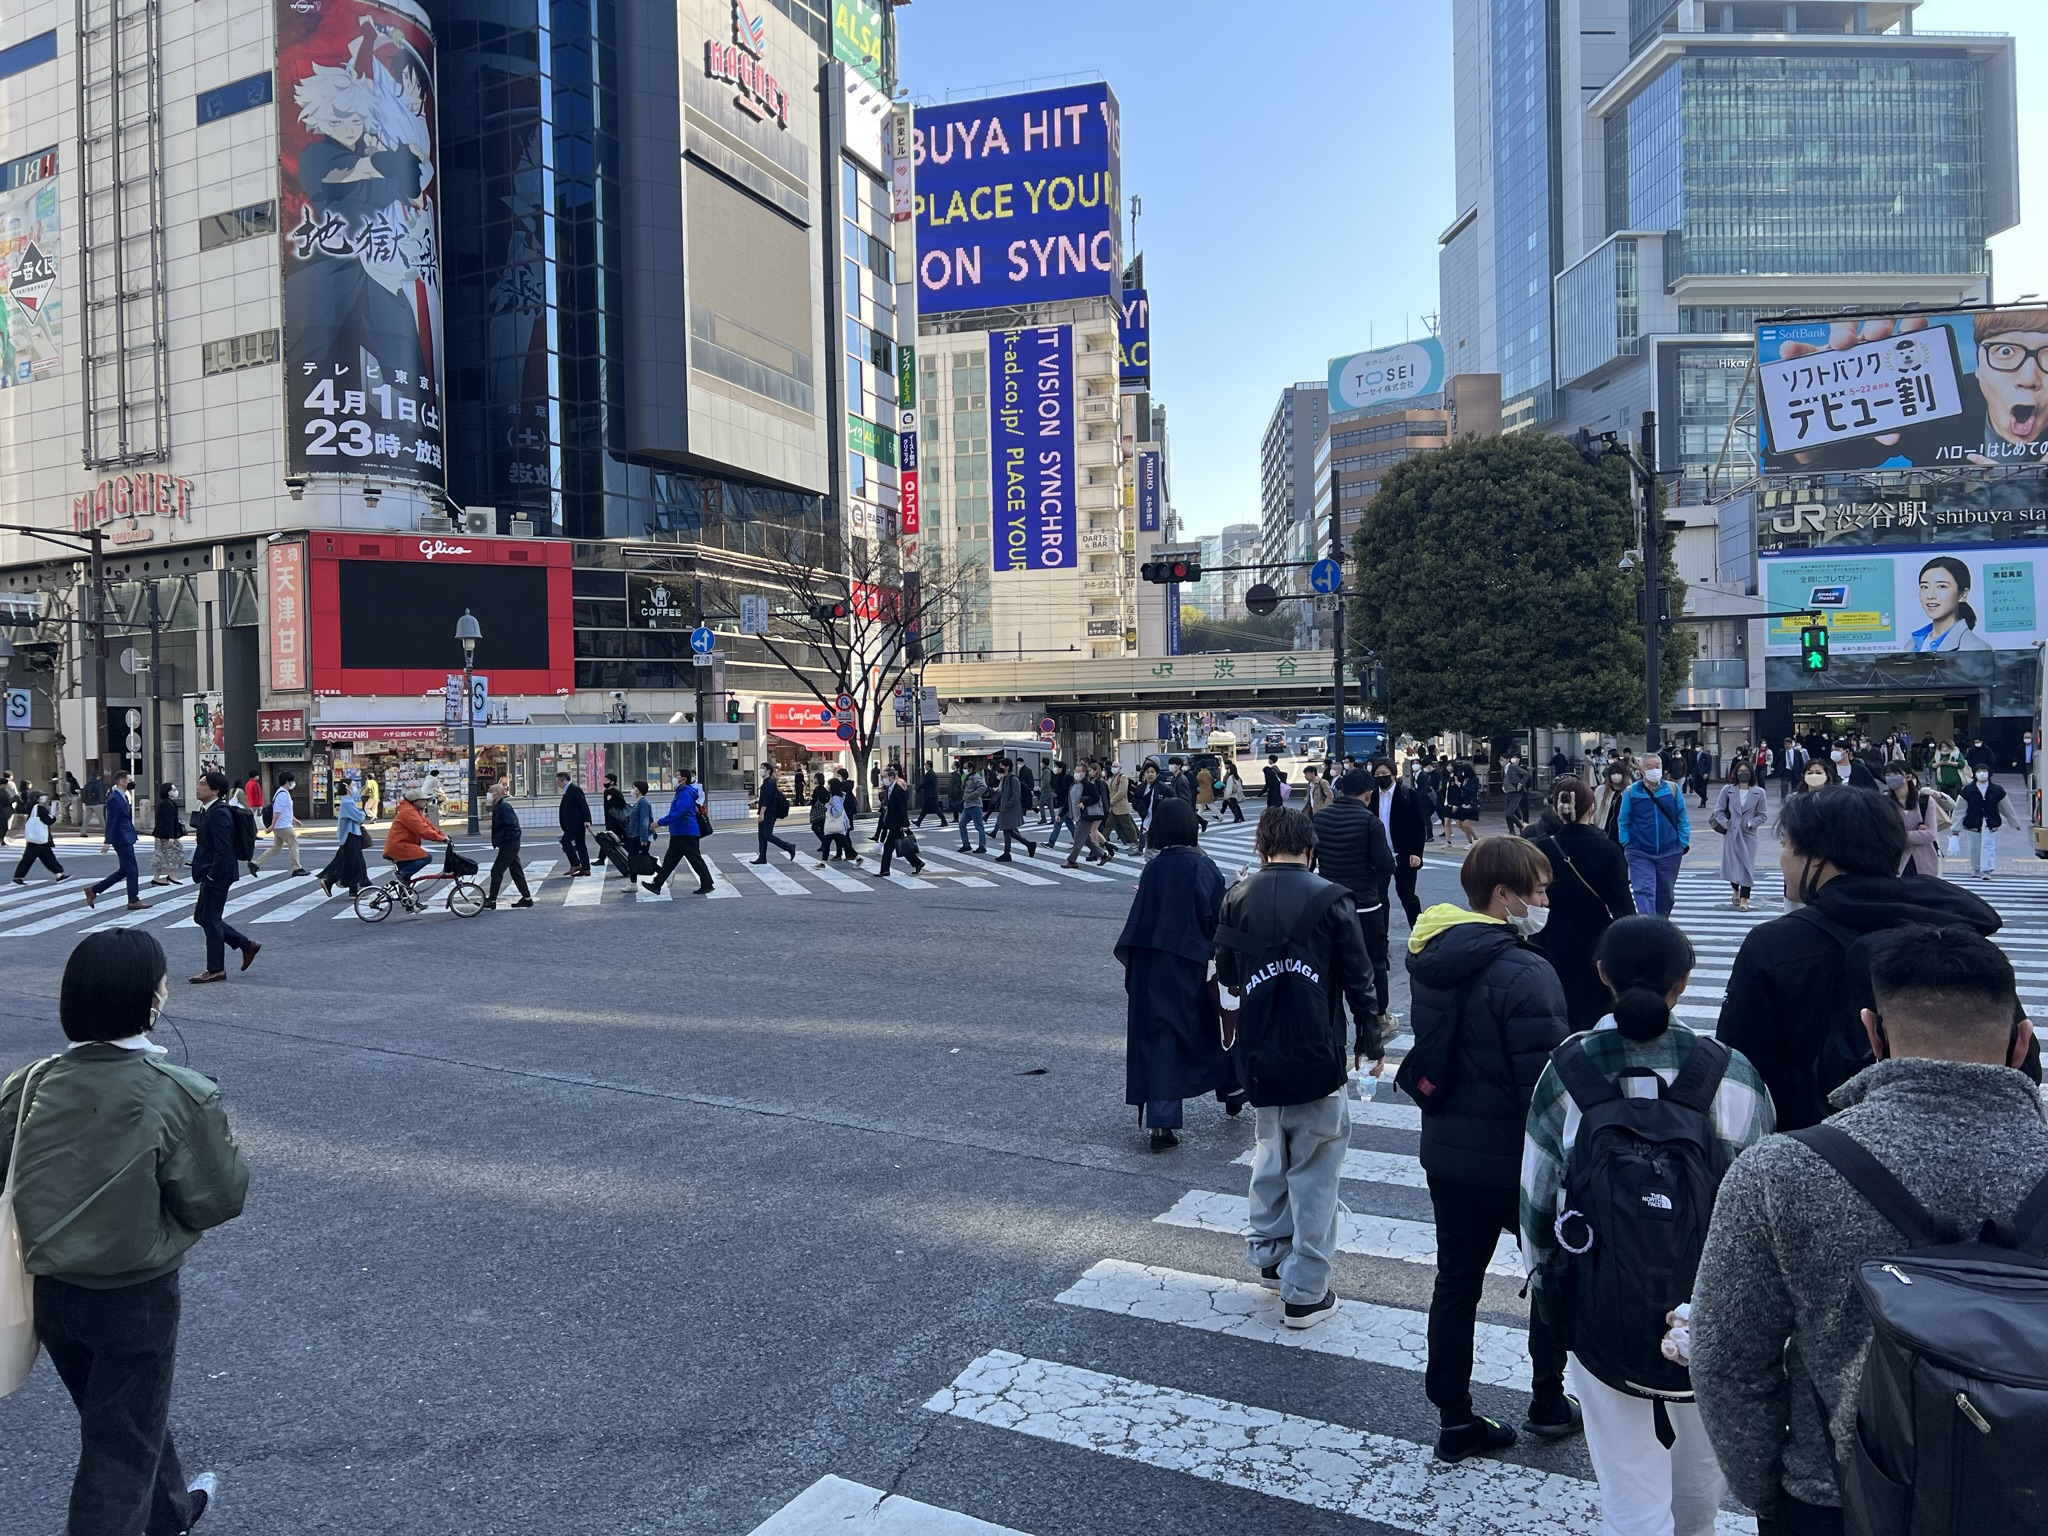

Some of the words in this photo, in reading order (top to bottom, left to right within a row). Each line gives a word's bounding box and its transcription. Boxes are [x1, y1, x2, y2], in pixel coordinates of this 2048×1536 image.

[835, 3, 882, 67] ALSA
[705, 39, 790, 128] MAGNET
[1023, 104, 1088, 151] HIT
[292, 205, 438, 290] 地獄楽
[11, 255, 53, 282] 一番くじ
[920, 245, 981, 291] ON
[1037, 327, 1060, 348] IT
[1778, 328, 1826, 340] SoftBank
[1355, 363, 1415, 388] TOSEI
[1782, 352, 1881, 392] ソフトバンク
[303, 378, 442, 432] 4月1日(土)
[1038, 353, 1061, 437] VISION
[1356, 380, 1415, 399] トーセイ株式会社
[1788, 373, 1937, 440] デビュー割
[1006, 447, 1026, 512] PLACE
[1146, 457, 1154, 490] MIZUHO
[73, 472, 194, 533] MAGNET
[905, 494, 916, 525] アコム
[1039, 451, 1063, 566] SYNCHRO
[1834, 500, 1929, 531] 渋谷駅
[1936, 508, 2012, 524] shibuya
[1773, 504, 1827, 534] JR
[272, 548, 298, 562] 名物
[419, 539, 472, 559] Glico
[1007, 516, 1027, 571] YOUR
[1126, 580, 1135, 588] 3F
[1800, 574, 1862, 584] 全員にプレゼント!
[276, 565, 297, 686] 天津甘栗
[641, 607, 682, 617] COFFEE
[1152, 662, 1174, 675] JR
[261, 717, 302, 732] 天津甘栗
[788, 707, 804, 725] Cozy
[321, 730, 369, 739] SANZENRI
